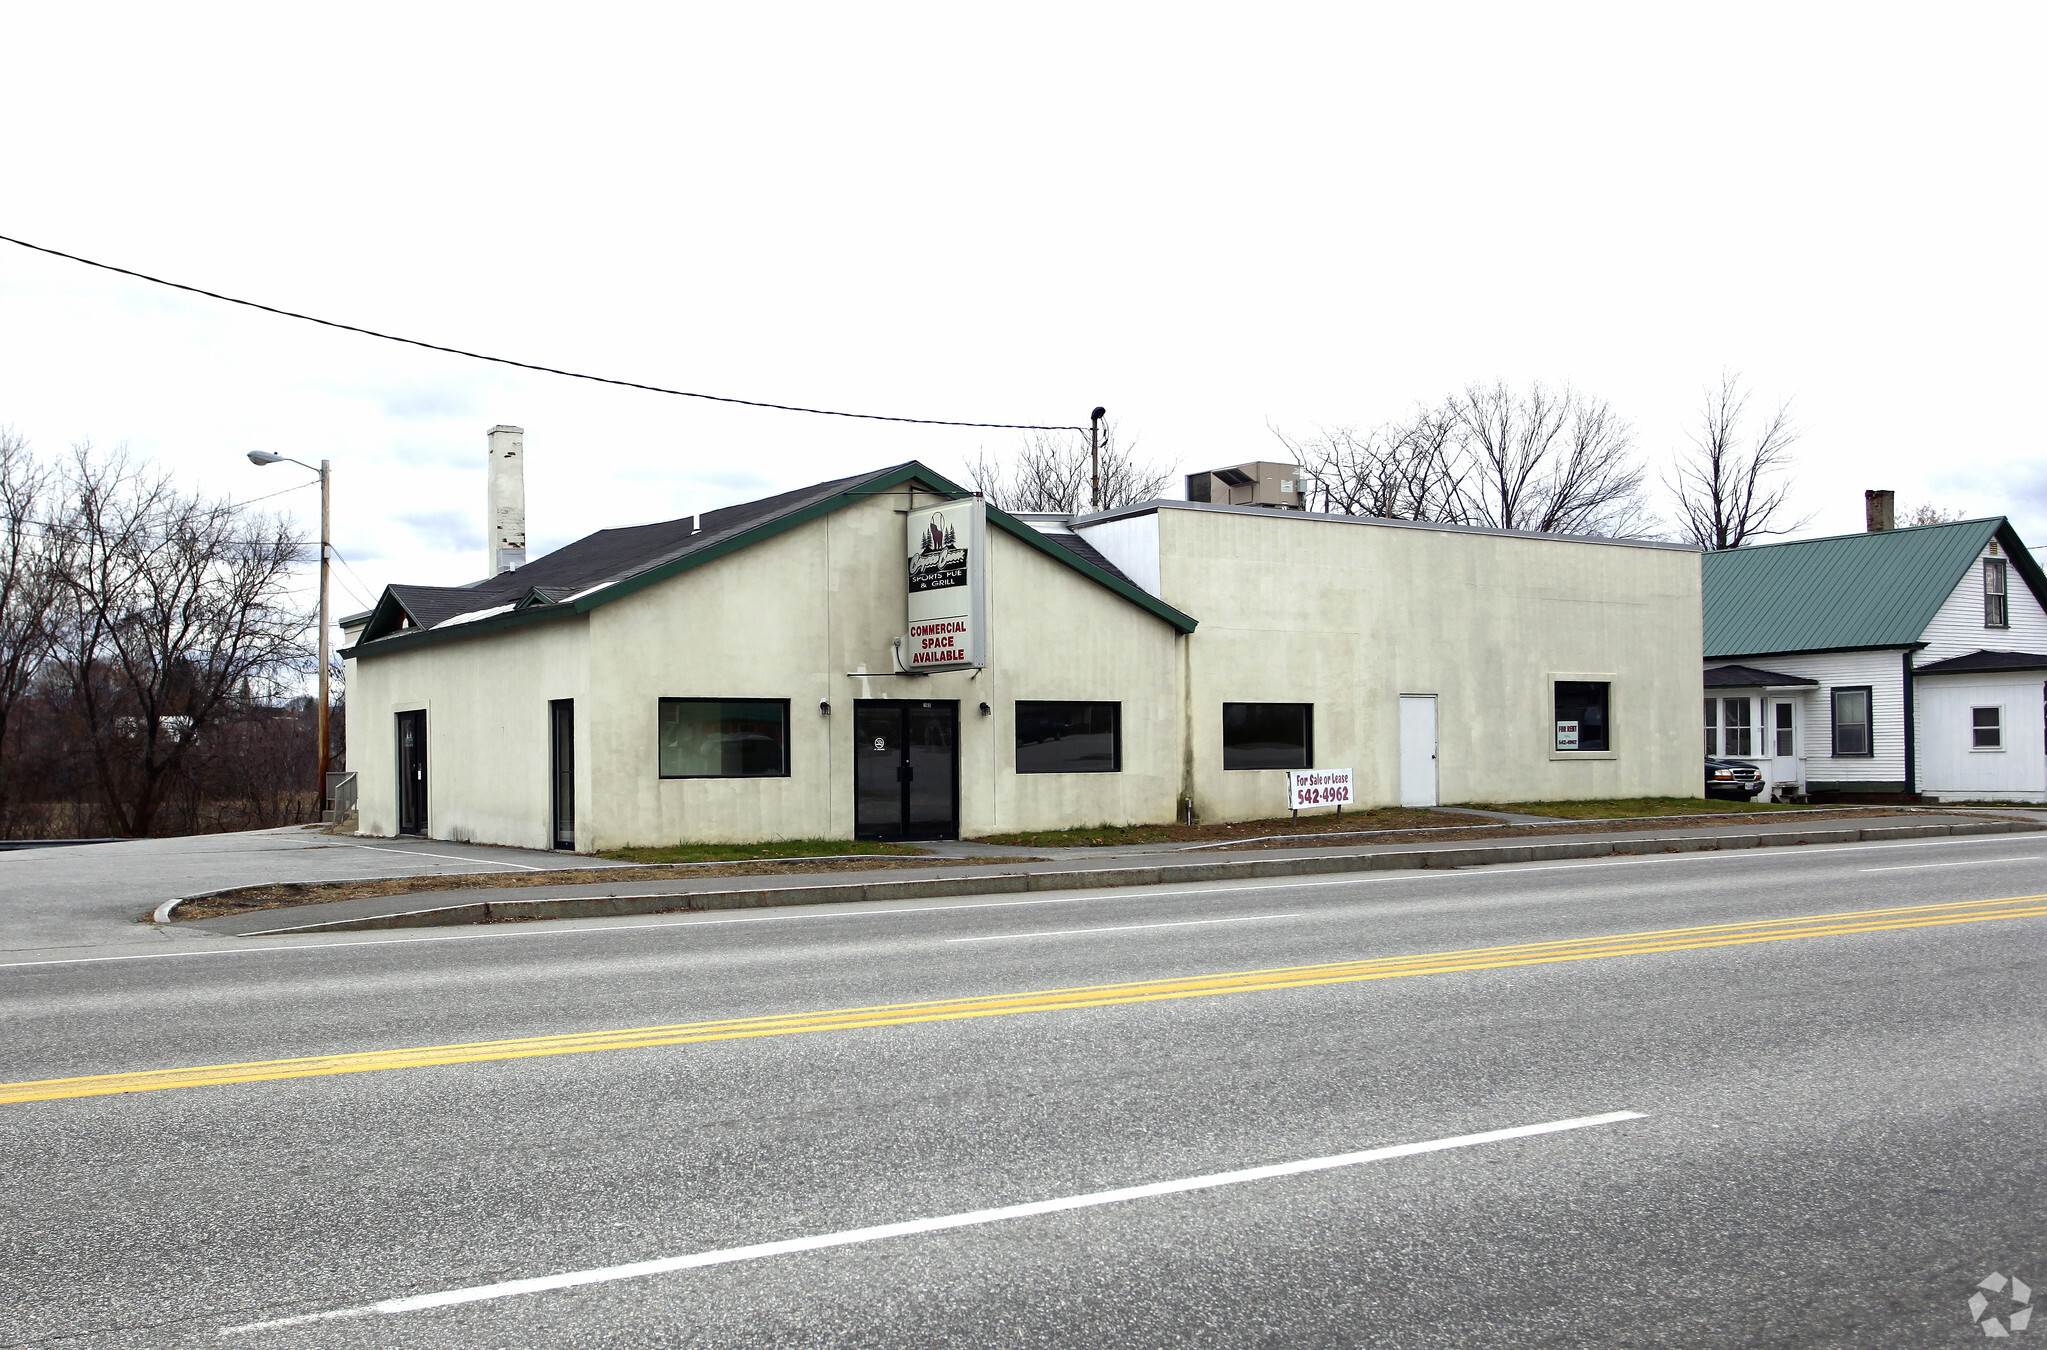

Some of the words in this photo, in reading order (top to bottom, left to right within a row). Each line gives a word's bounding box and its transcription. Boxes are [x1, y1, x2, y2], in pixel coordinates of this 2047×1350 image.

[912, 573, 942, 582] SPORTS
[931, 578, 955, 587] GRILL
[911, 621, 966, 637] COMMERCIAL
[922, 636, 954, 649] SPACE
[913, 649, 964, 663] AVAILABLE
[1296, 775, 1308, 786] For
[1309, 773, 1323, 786] Sale
[1332, 773, 1348, 784] Lease
